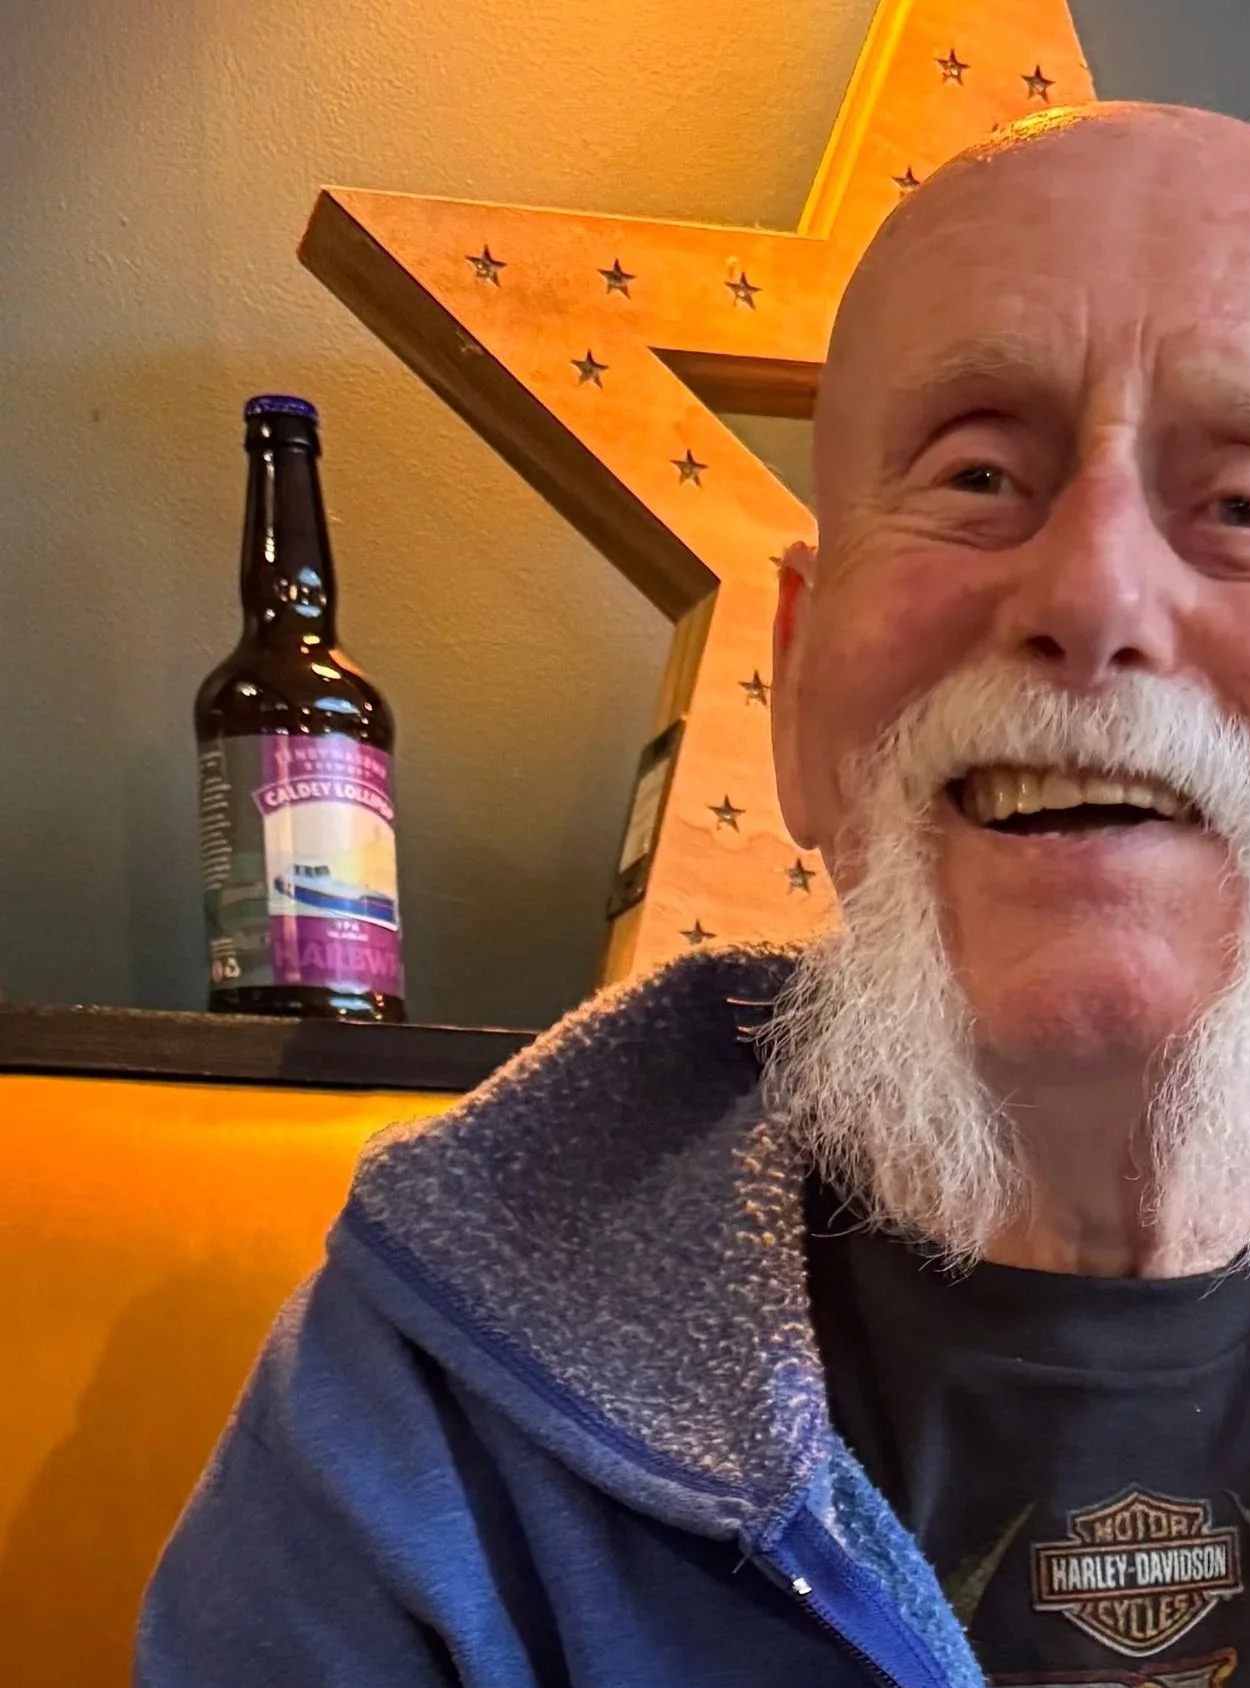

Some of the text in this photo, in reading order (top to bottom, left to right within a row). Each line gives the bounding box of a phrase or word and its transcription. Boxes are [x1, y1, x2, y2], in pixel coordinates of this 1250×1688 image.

[264, 782, 331, 806] CALDEY
[1093, 1508, 1188, 1544] MOTOR
[1052, 1545, 1227, 1592] HARLEY-DAVIDSON
[1097, 1596, 1191, 1639] CYCLES
